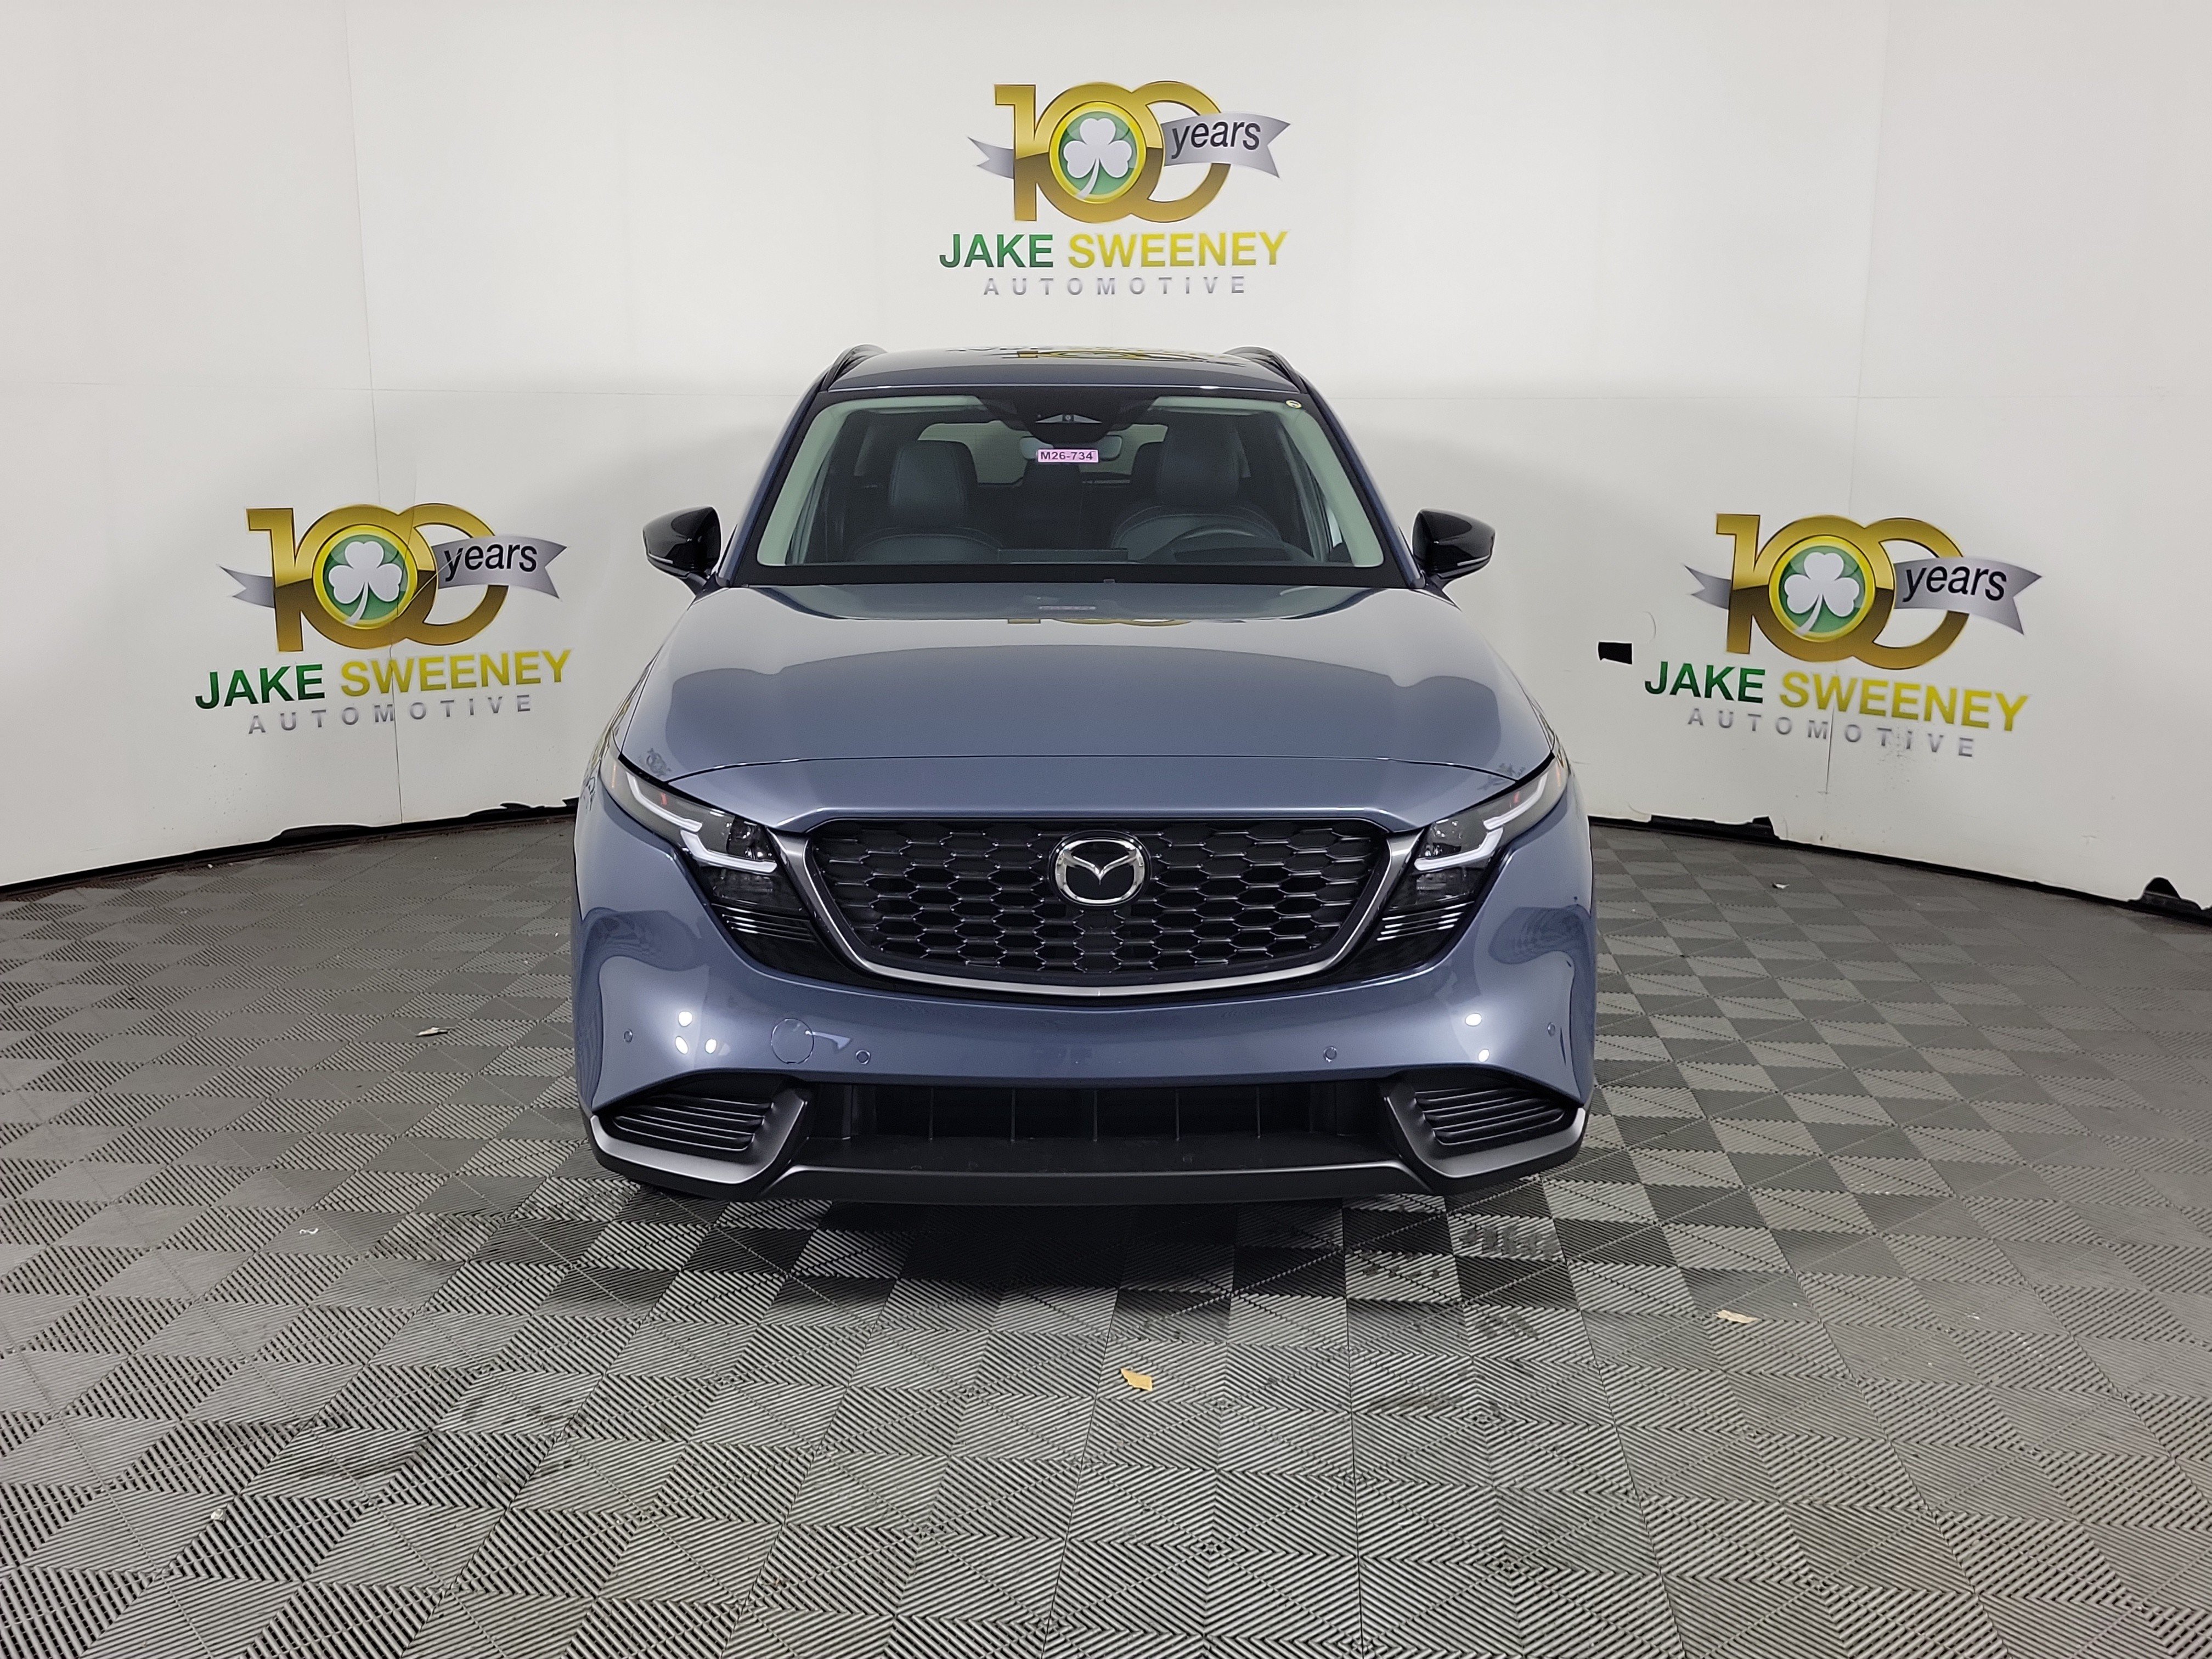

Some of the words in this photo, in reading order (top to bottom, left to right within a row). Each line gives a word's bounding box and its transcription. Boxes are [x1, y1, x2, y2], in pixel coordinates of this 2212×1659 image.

[994, 80, 1232, 224] 100
[1171, 120, 1261, 160] years
[939, 234, 1054, 268] JAKE
[1068, 231, 1288, 268] SWEENEY
[983, 275, 1246, 296] AUTOMOTIVE
[1040, 450, 1093, 460] M26-734
[246, 503, 509, 653] 100
[444, 540, 538, 582] years
[1716, 513, 1970, 670] 100
[1903, 563, 2007, 602] years
[195, 663, 325, 710] JAKE
[340, 650, 573, 697] SWEENEY
[1644, 661, 1766, 704] JAKE
[1779, 671, 2029, 732] SWEENEY
[248, 694, 532, 735] AUTOMOTIVE
[1688, 708, 1974, 758] AUTOMOTIVE
